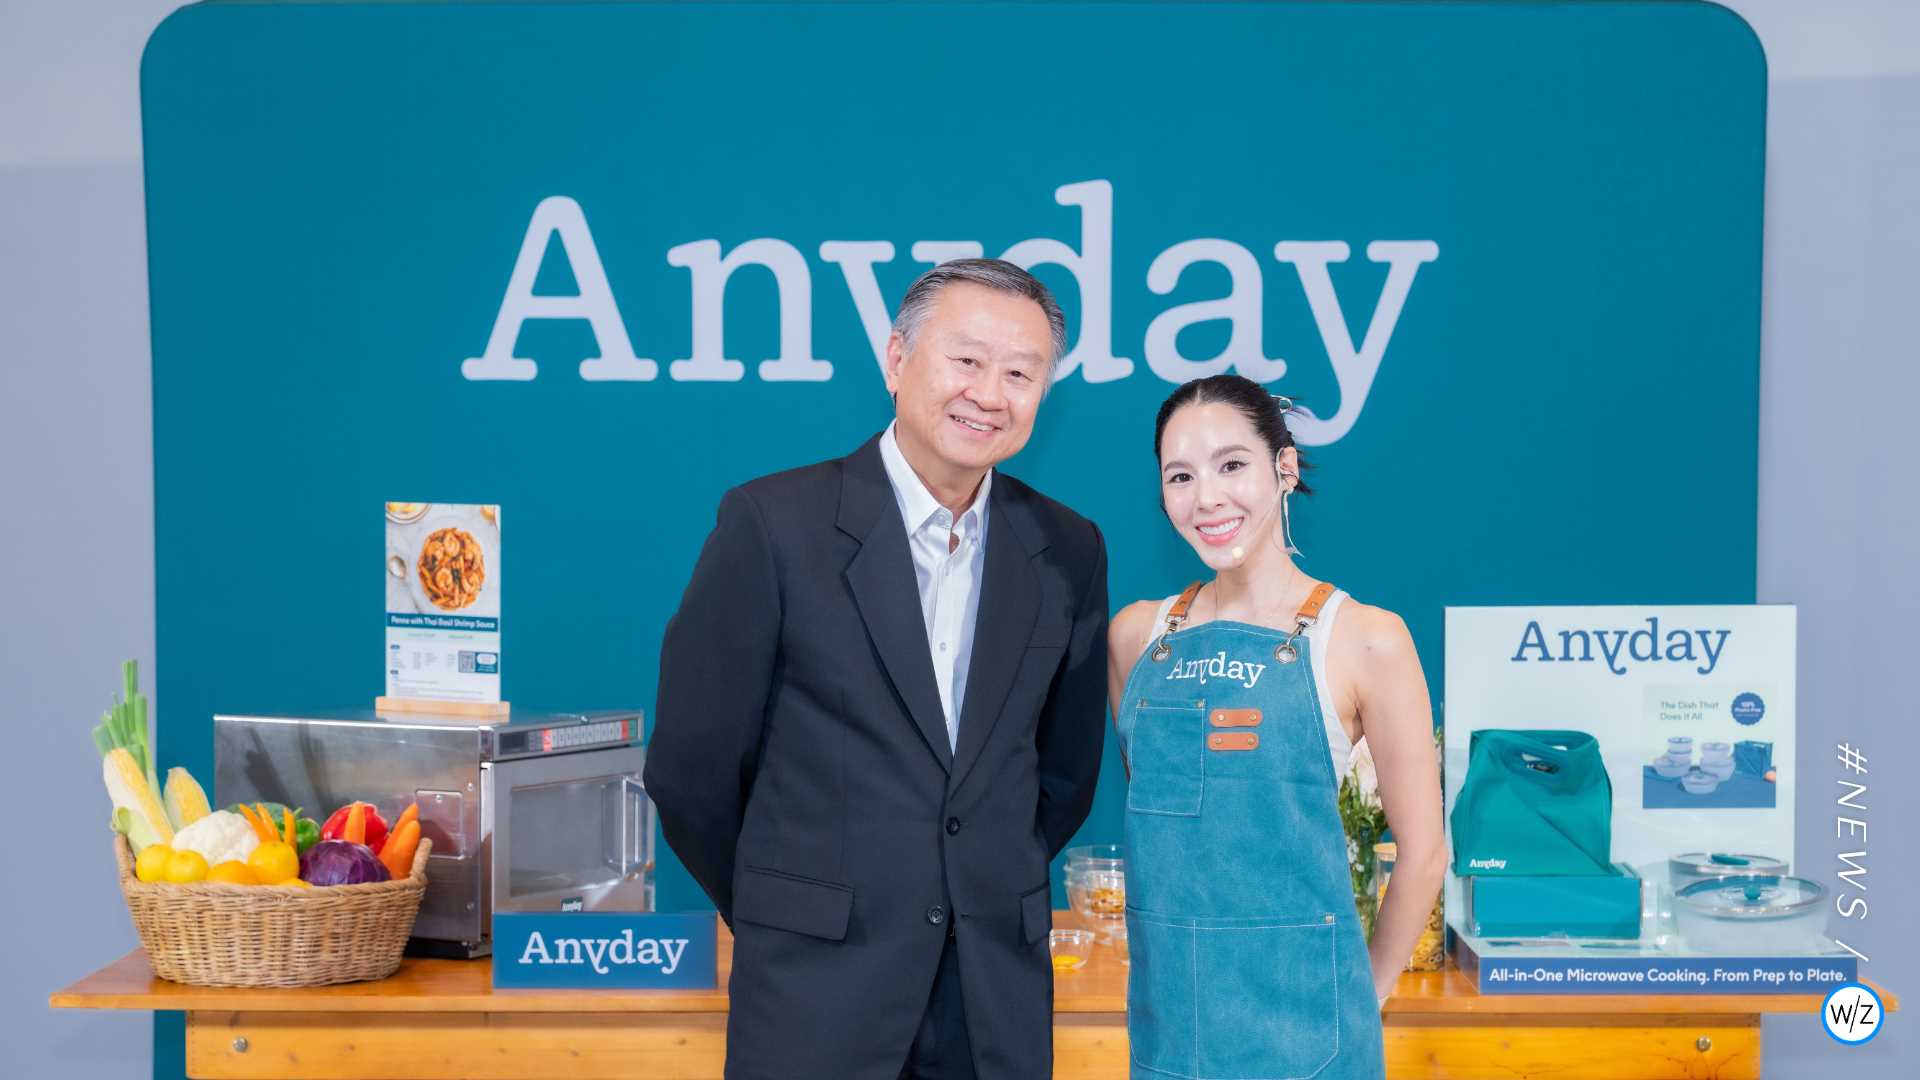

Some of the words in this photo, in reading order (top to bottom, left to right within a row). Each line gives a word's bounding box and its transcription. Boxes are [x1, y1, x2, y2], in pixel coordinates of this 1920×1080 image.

[1511, 616, 1732, 675] Anyday
[1166, 651, 1267, 688] Anyday
[1660, 701, 1676, 709] The
[1678, 701, 1697, 709] Dish
[1660, 712, 1681, 721] Does
[1691, 712, 1703, 721] All
[1469, 858, 1507, 870] Anyday
[518, 929, 689, 975] Anyday
[1489, 968, 1564, 982] All-in-One
[1567, 968, 1645, 982] Microwave
[1647, 968, 1710, 985] Cooking.
[1713, 968, 1750, 982] From
[1753, 968, 1786, 985] Prep
[1788, 969, 1804, 982] to
[1807, 968, 1848, 982] Plate.
